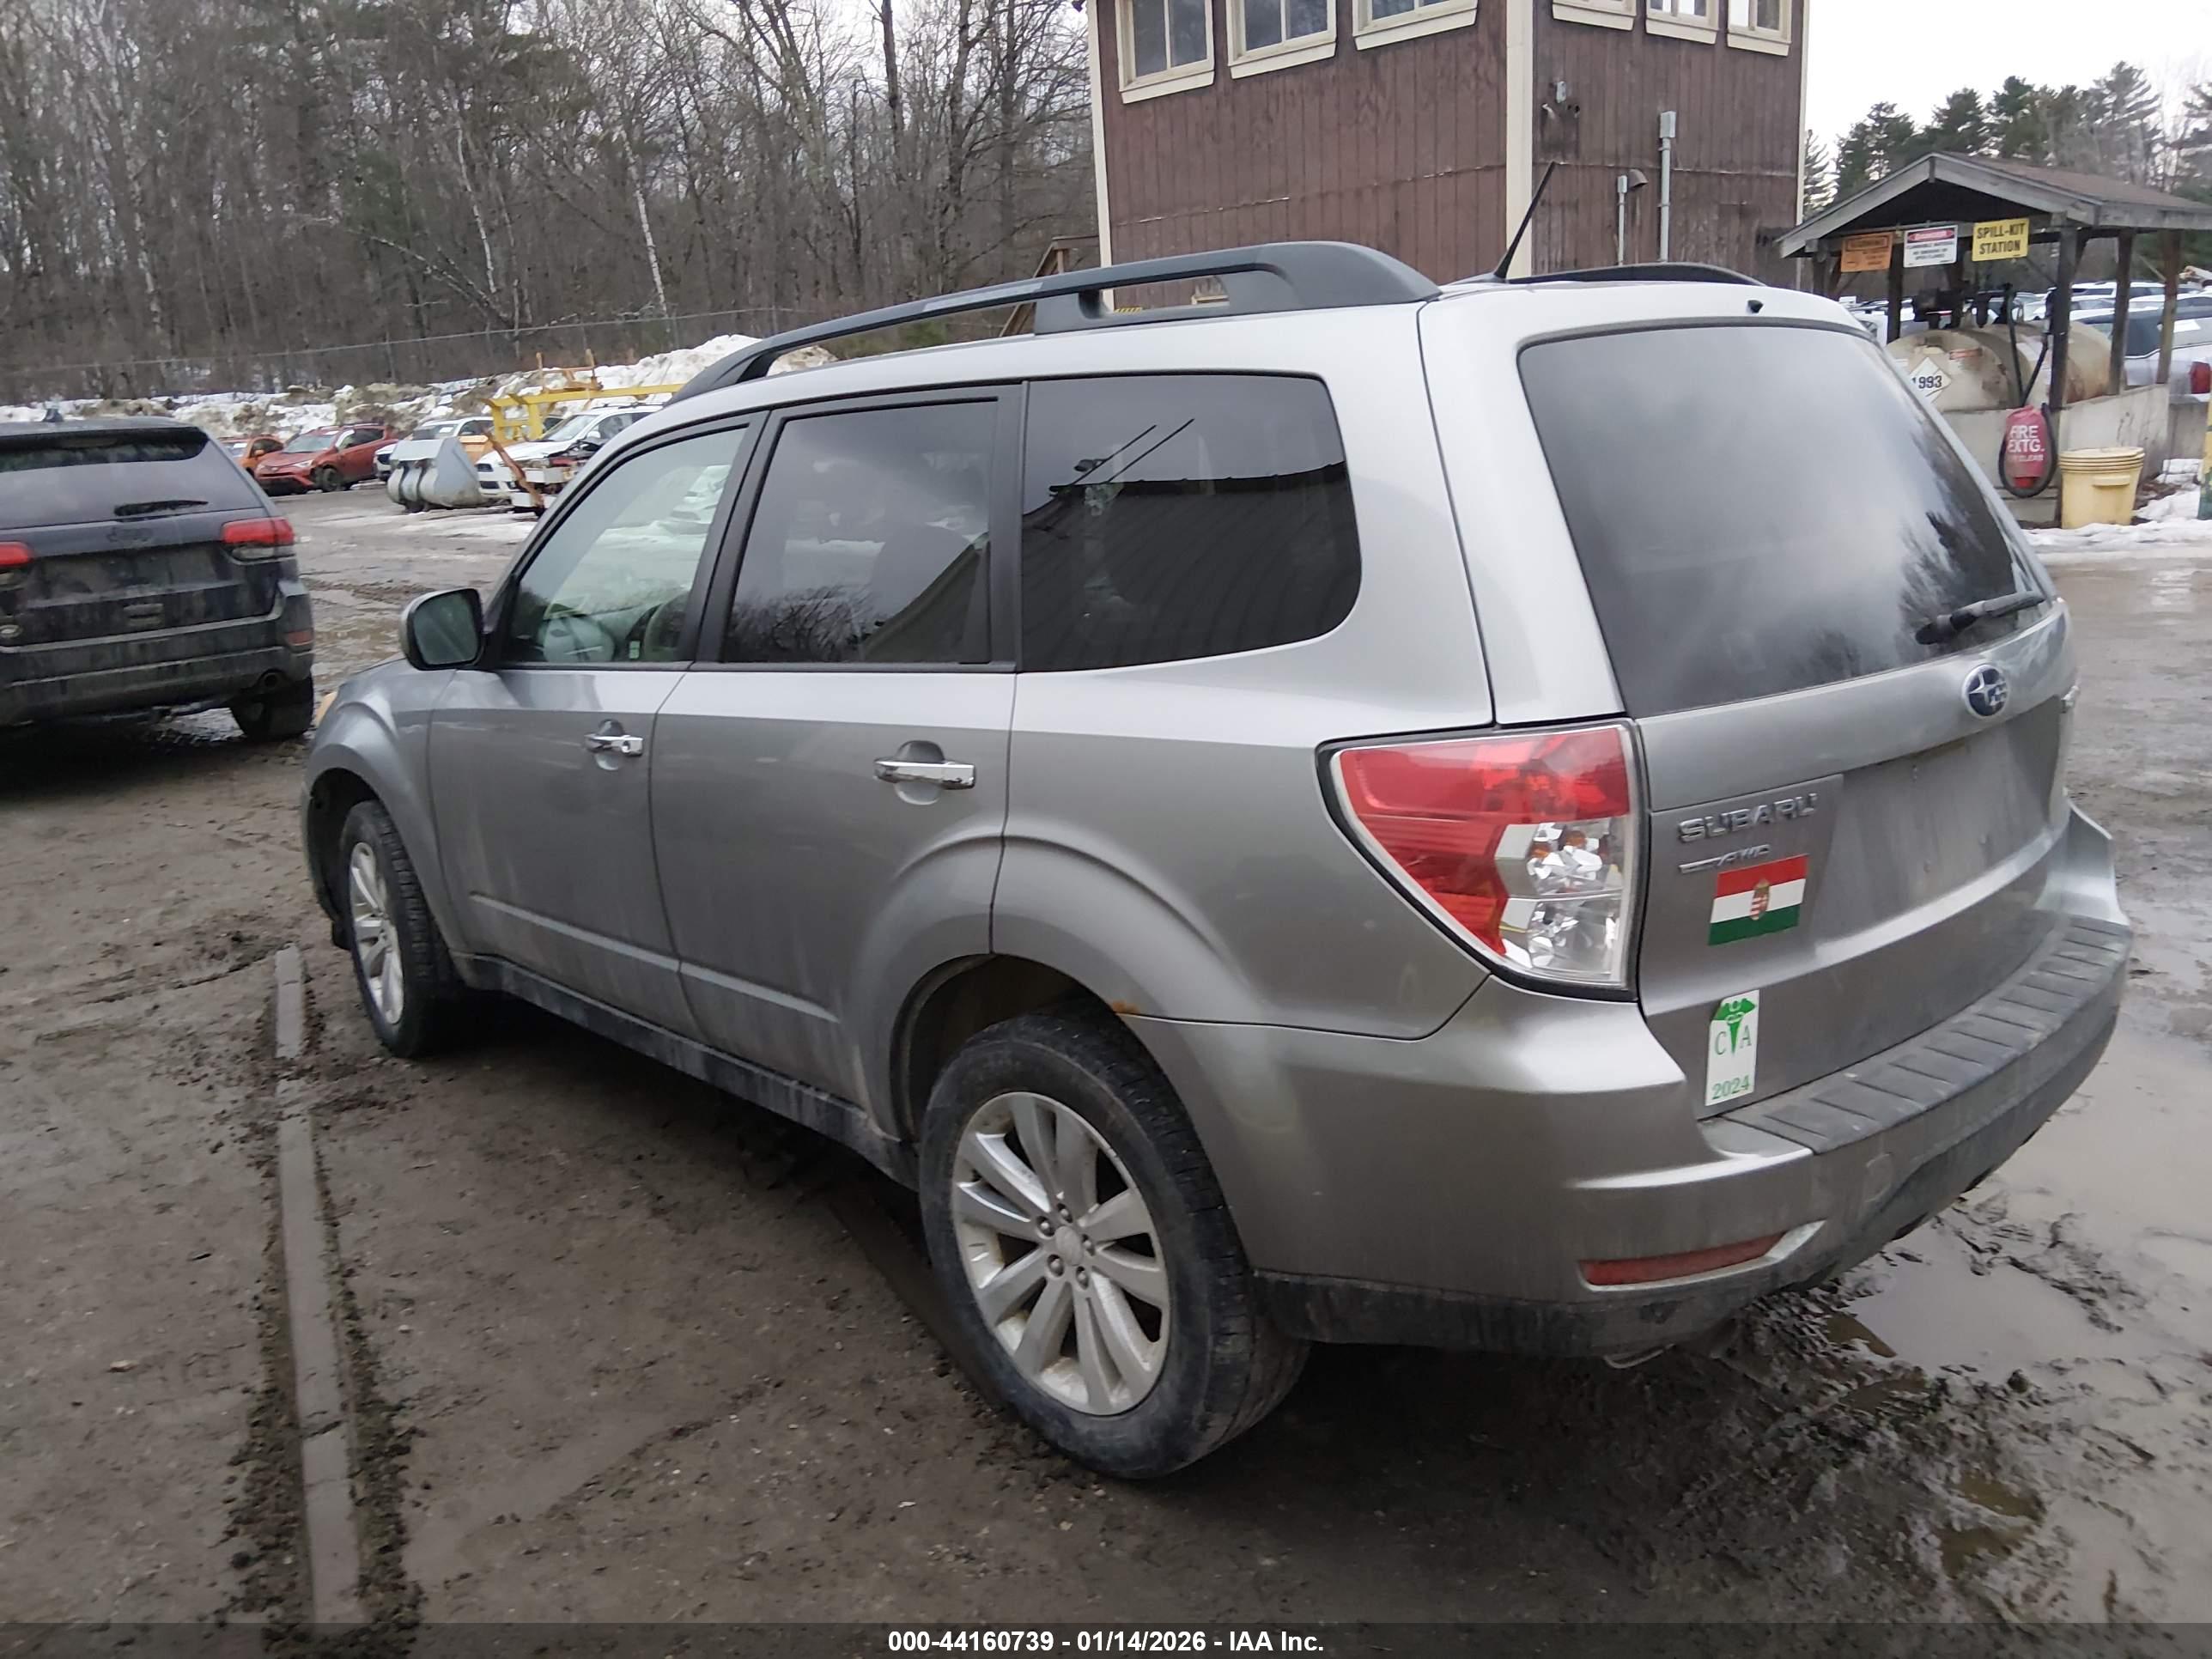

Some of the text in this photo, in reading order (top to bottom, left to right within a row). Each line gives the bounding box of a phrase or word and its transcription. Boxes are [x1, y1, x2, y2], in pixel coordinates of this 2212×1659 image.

[1977, 223, 2026, 239] SPILL-KIT
[1979, 240, 2021, 254] STATION
[1678, 793, 1818, 842] SUBARU
[1711, 1075, 1750, 1100] 2024
